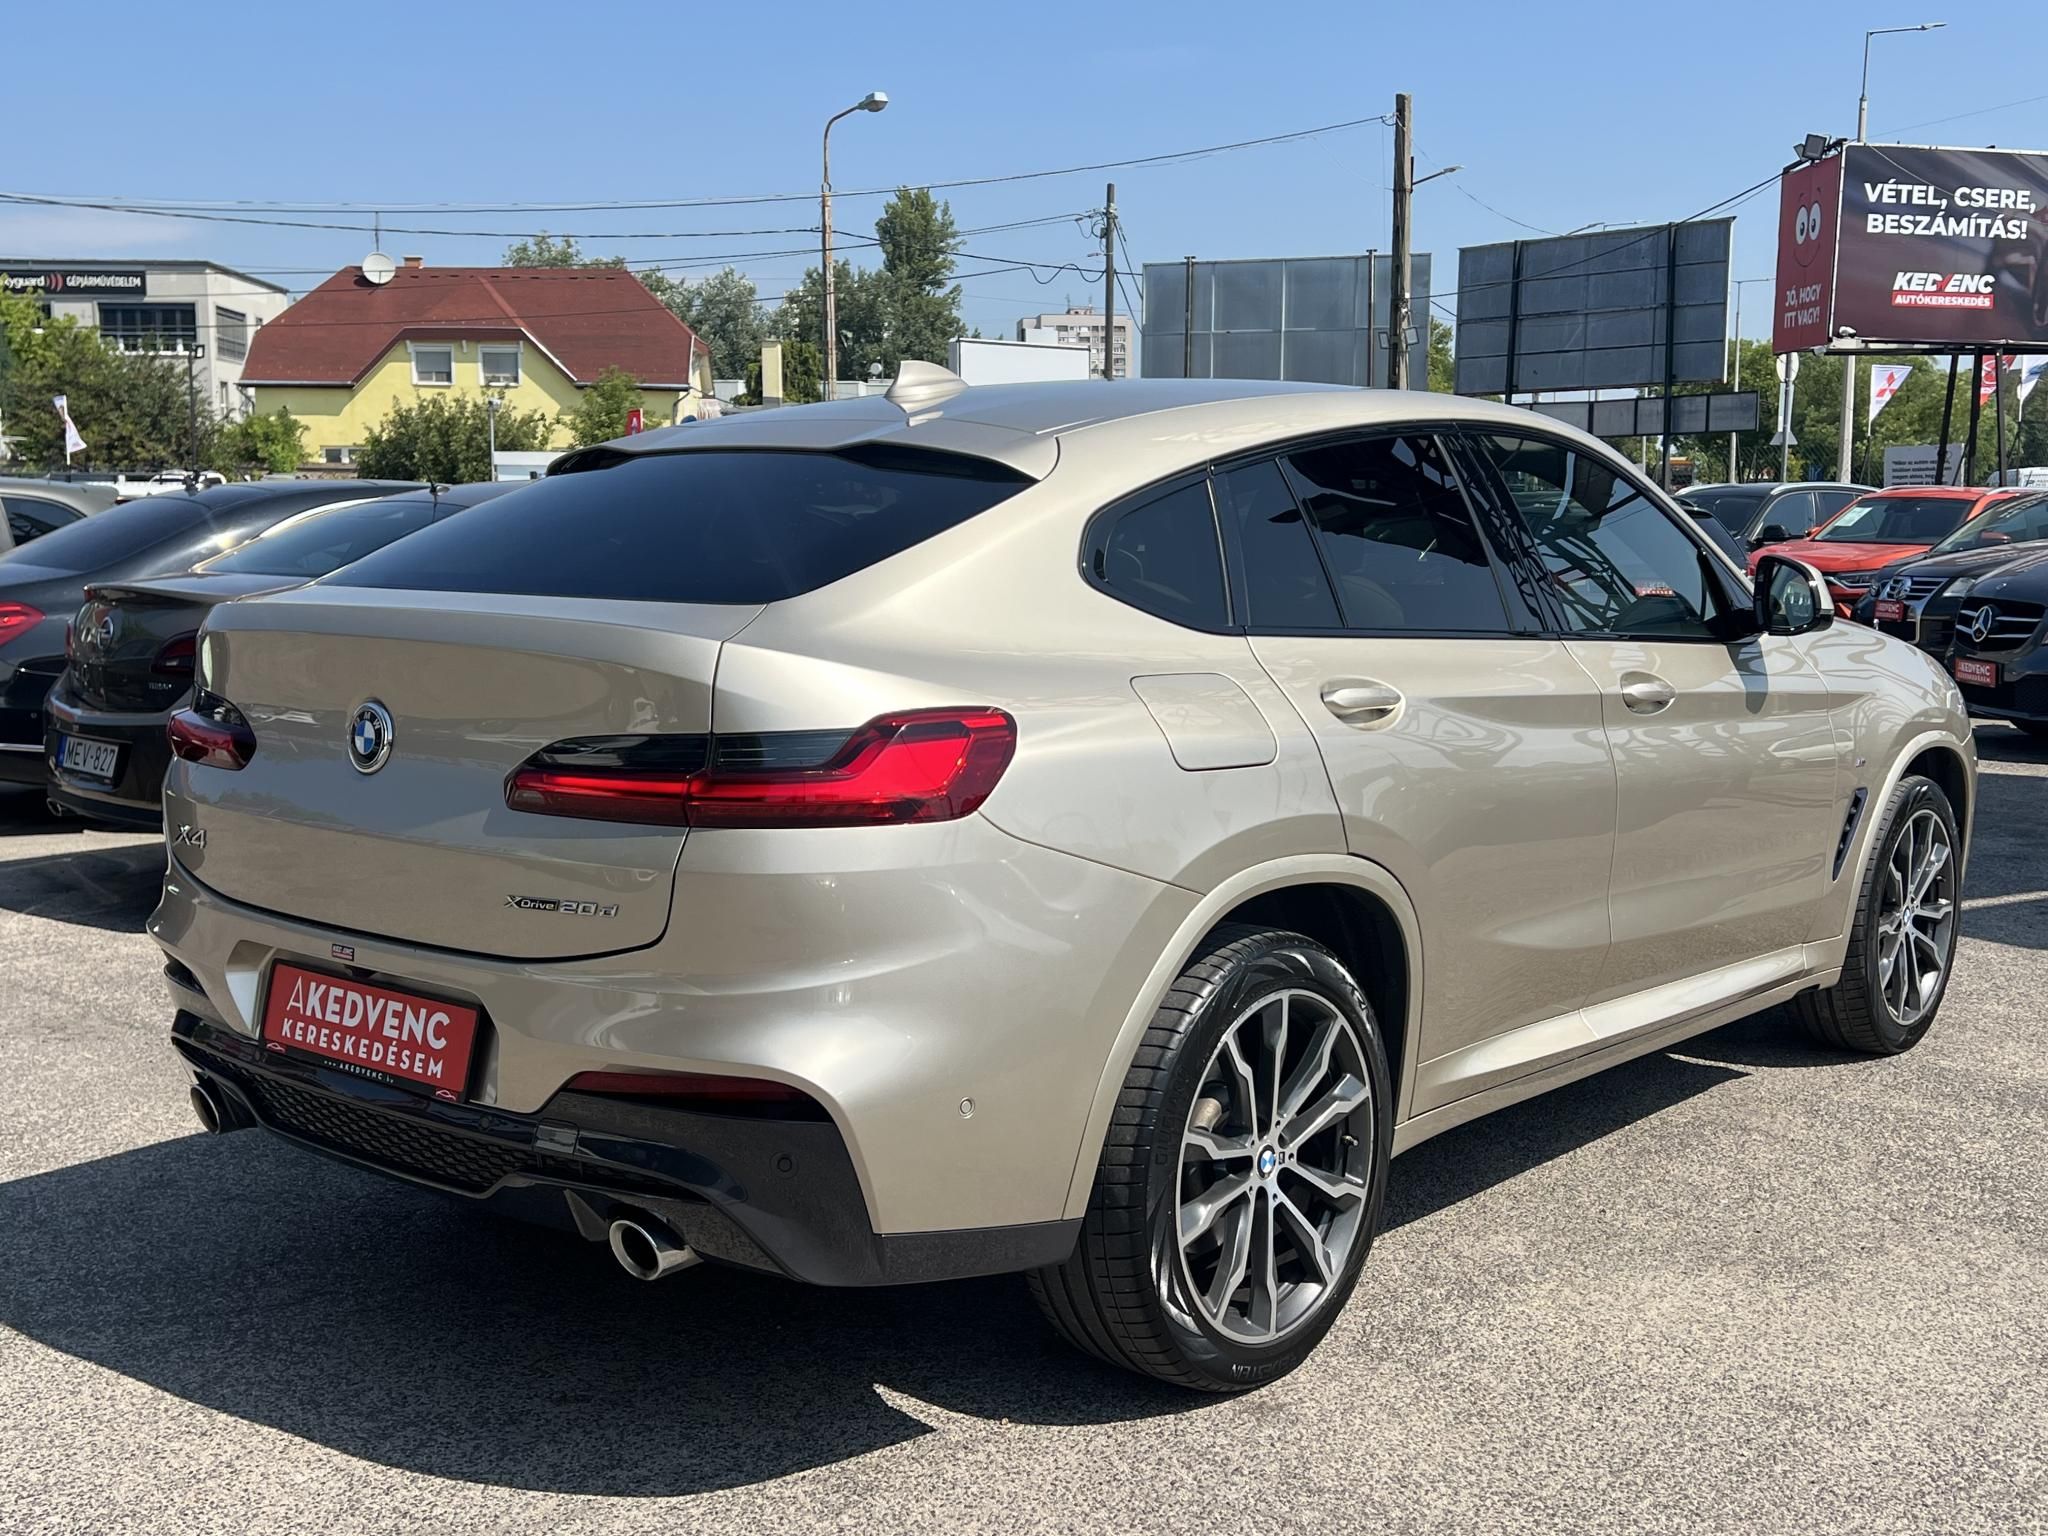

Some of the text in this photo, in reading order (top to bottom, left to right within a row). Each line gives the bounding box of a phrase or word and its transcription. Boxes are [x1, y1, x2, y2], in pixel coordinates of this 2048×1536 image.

[1864, 180, 2037, 214] VÉTEL, CSERE,
[1866, 211, 2028, 240] BESZÁMÍTÁS!
[1785, 283, 1822, 308] JÓ, HOGY
[1894, 293, 1991, 307] AUTÓKERESKEDÉS
[1784, 306, 1820, 328] ITT VAGY!
[66, 740, 116, 772] MEV-827
[172, 824, 206, 849] X4
[281, 1017, 443, 1079] KERESKEDÉSEM
